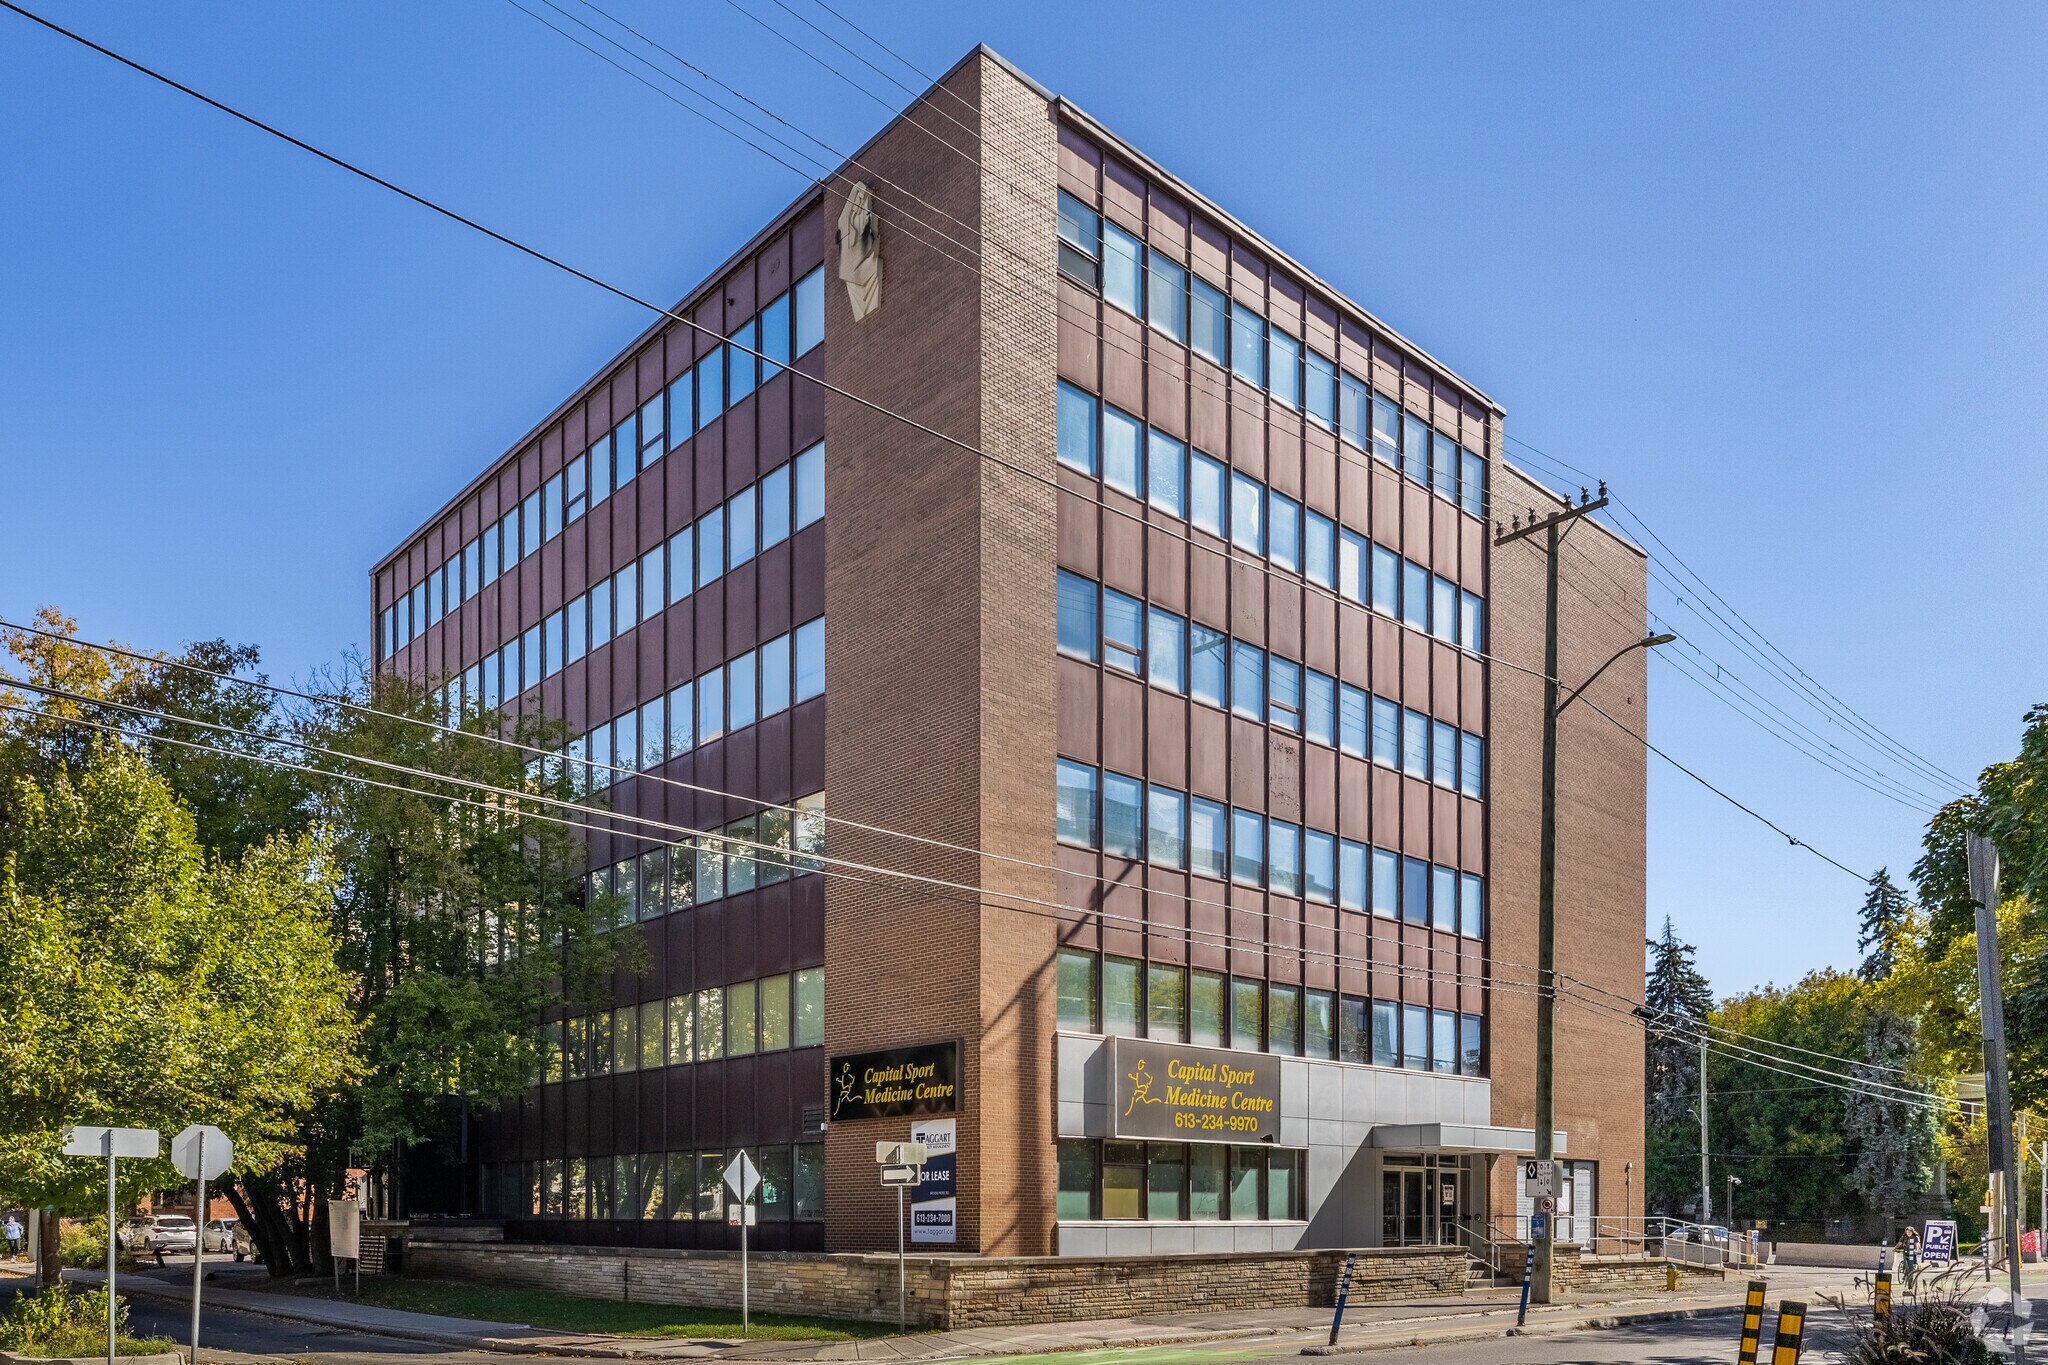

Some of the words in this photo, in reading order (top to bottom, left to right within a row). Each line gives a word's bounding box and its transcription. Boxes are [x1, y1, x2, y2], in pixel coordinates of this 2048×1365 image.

[864, 1064, 903, 1087] Capital
[905, 1062, 935, 1083] Sport
[1167, 1059, 1217, 1085] Capital
[1219, 1064, 1255, 1089] Sport
[864, 1086, 913, 1105] Medicine
[915, 1082, 954, 1100] Centre
[1164, 1085, 1227, 1109] Medicine
[1231, 1091, 1273, 1112] Centre
[1175, 1112, 1258, 1132] 613-234-9970
[916, 1132, 951, 1143] TAGGART
[921, 1171, 930, 1181] OR
[931, 1170, 950, 1181] LEASE
[1926, 1226, 1943, 1243] P
[1923, 1251, 1949, 1260] OPEN
